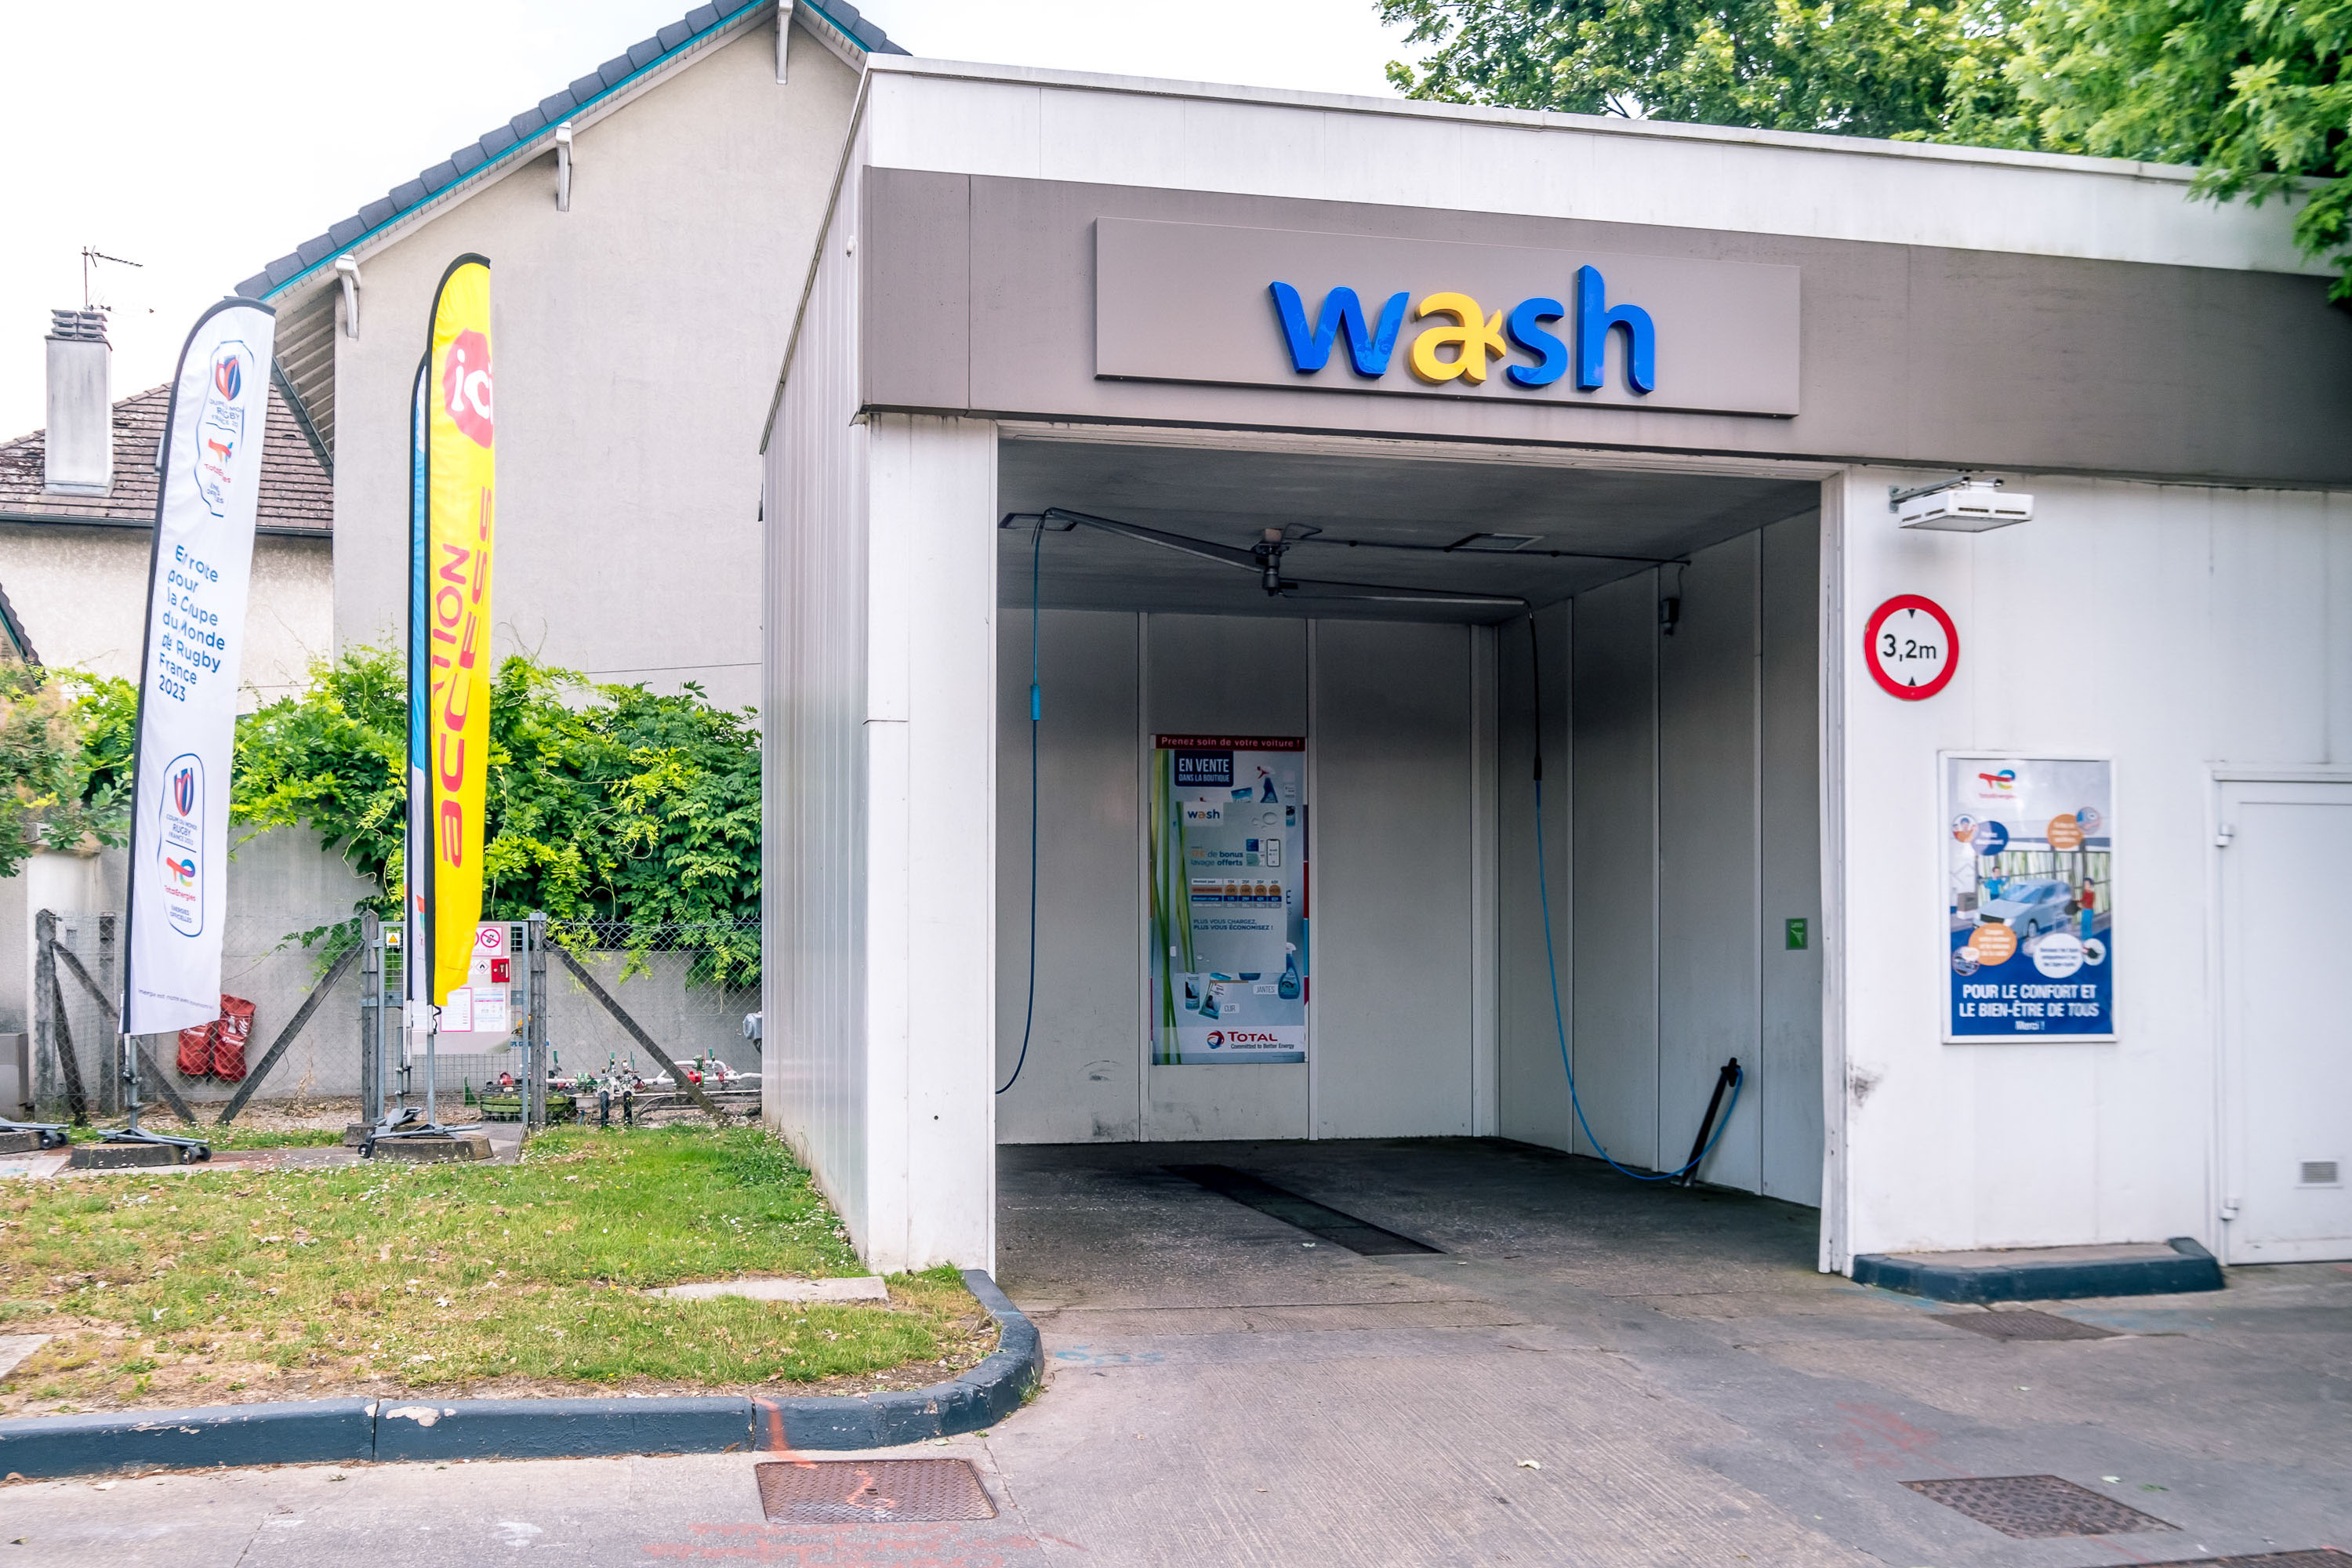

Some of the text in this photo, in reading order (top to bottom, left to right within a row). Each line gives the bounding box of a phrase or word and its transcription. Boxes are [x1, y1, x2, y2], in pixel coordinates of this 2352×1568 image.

[1267, 264, 1655, 395] wash
[189, 557, 219, 583] rote
[167, 569, 199, 593] pour
[167, 586, 177, 606] la
[162, 610, 178, 630] du
[1882, 633, 1936, 662] 3,2m
[176, 640, 221, 673] Rugby
[159, 652, 198, 685] France
[159, 674, 186, 702] 2023
[1161, 737, 1194, 746] Prenez
[1261, 739, 1294, 748] voiture
[1178, 758, 1230, 773] EN VENTE
[1178, 773, 1230, 782] DANS LA BOUTIQUE
[1187, 809, 1220, 820] wash
[172, 823, 191, 837] RUGBY
[1191, 858, 1215, 867] lavage
[1962, 984, 2096, 999] POUR LE CONFORT ET
[1959, 1000, 2100, 1017] LE BIEN-ÊTRE DE TOUS
[2015, 1021, 2039, 1030] Merci
[1227, 1031, 1278, 1042] TOTAL
